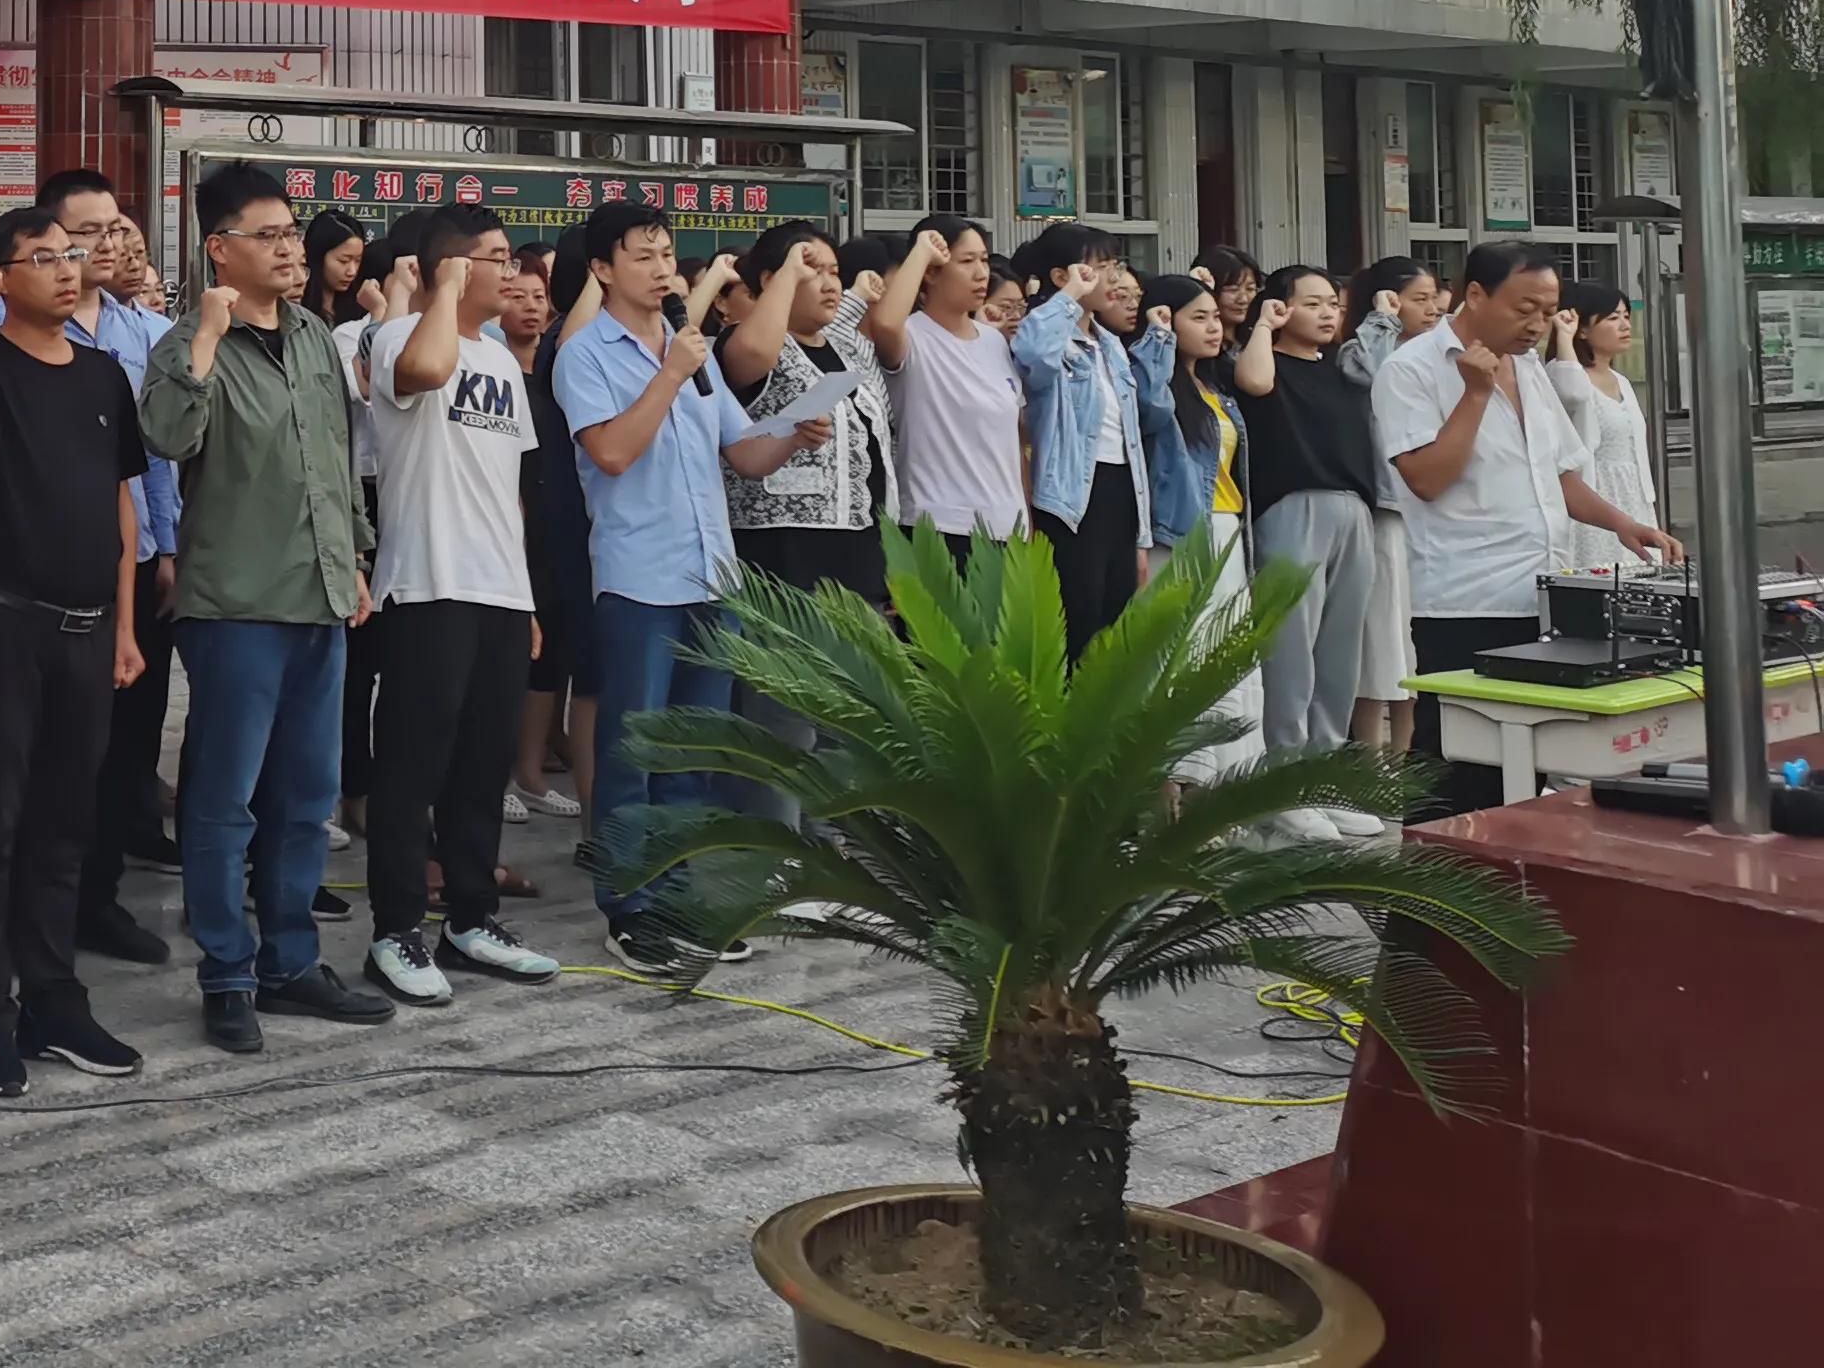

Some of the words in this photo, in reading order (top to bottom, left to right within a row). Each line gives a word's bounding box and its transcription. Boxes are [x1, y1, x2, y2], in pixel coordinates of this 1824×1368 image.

[285, 167, 519, 205] 深化知行合一
[566, 177, 769, 213] 夯实习惯养成
[454, 369, 514, 419] KM
